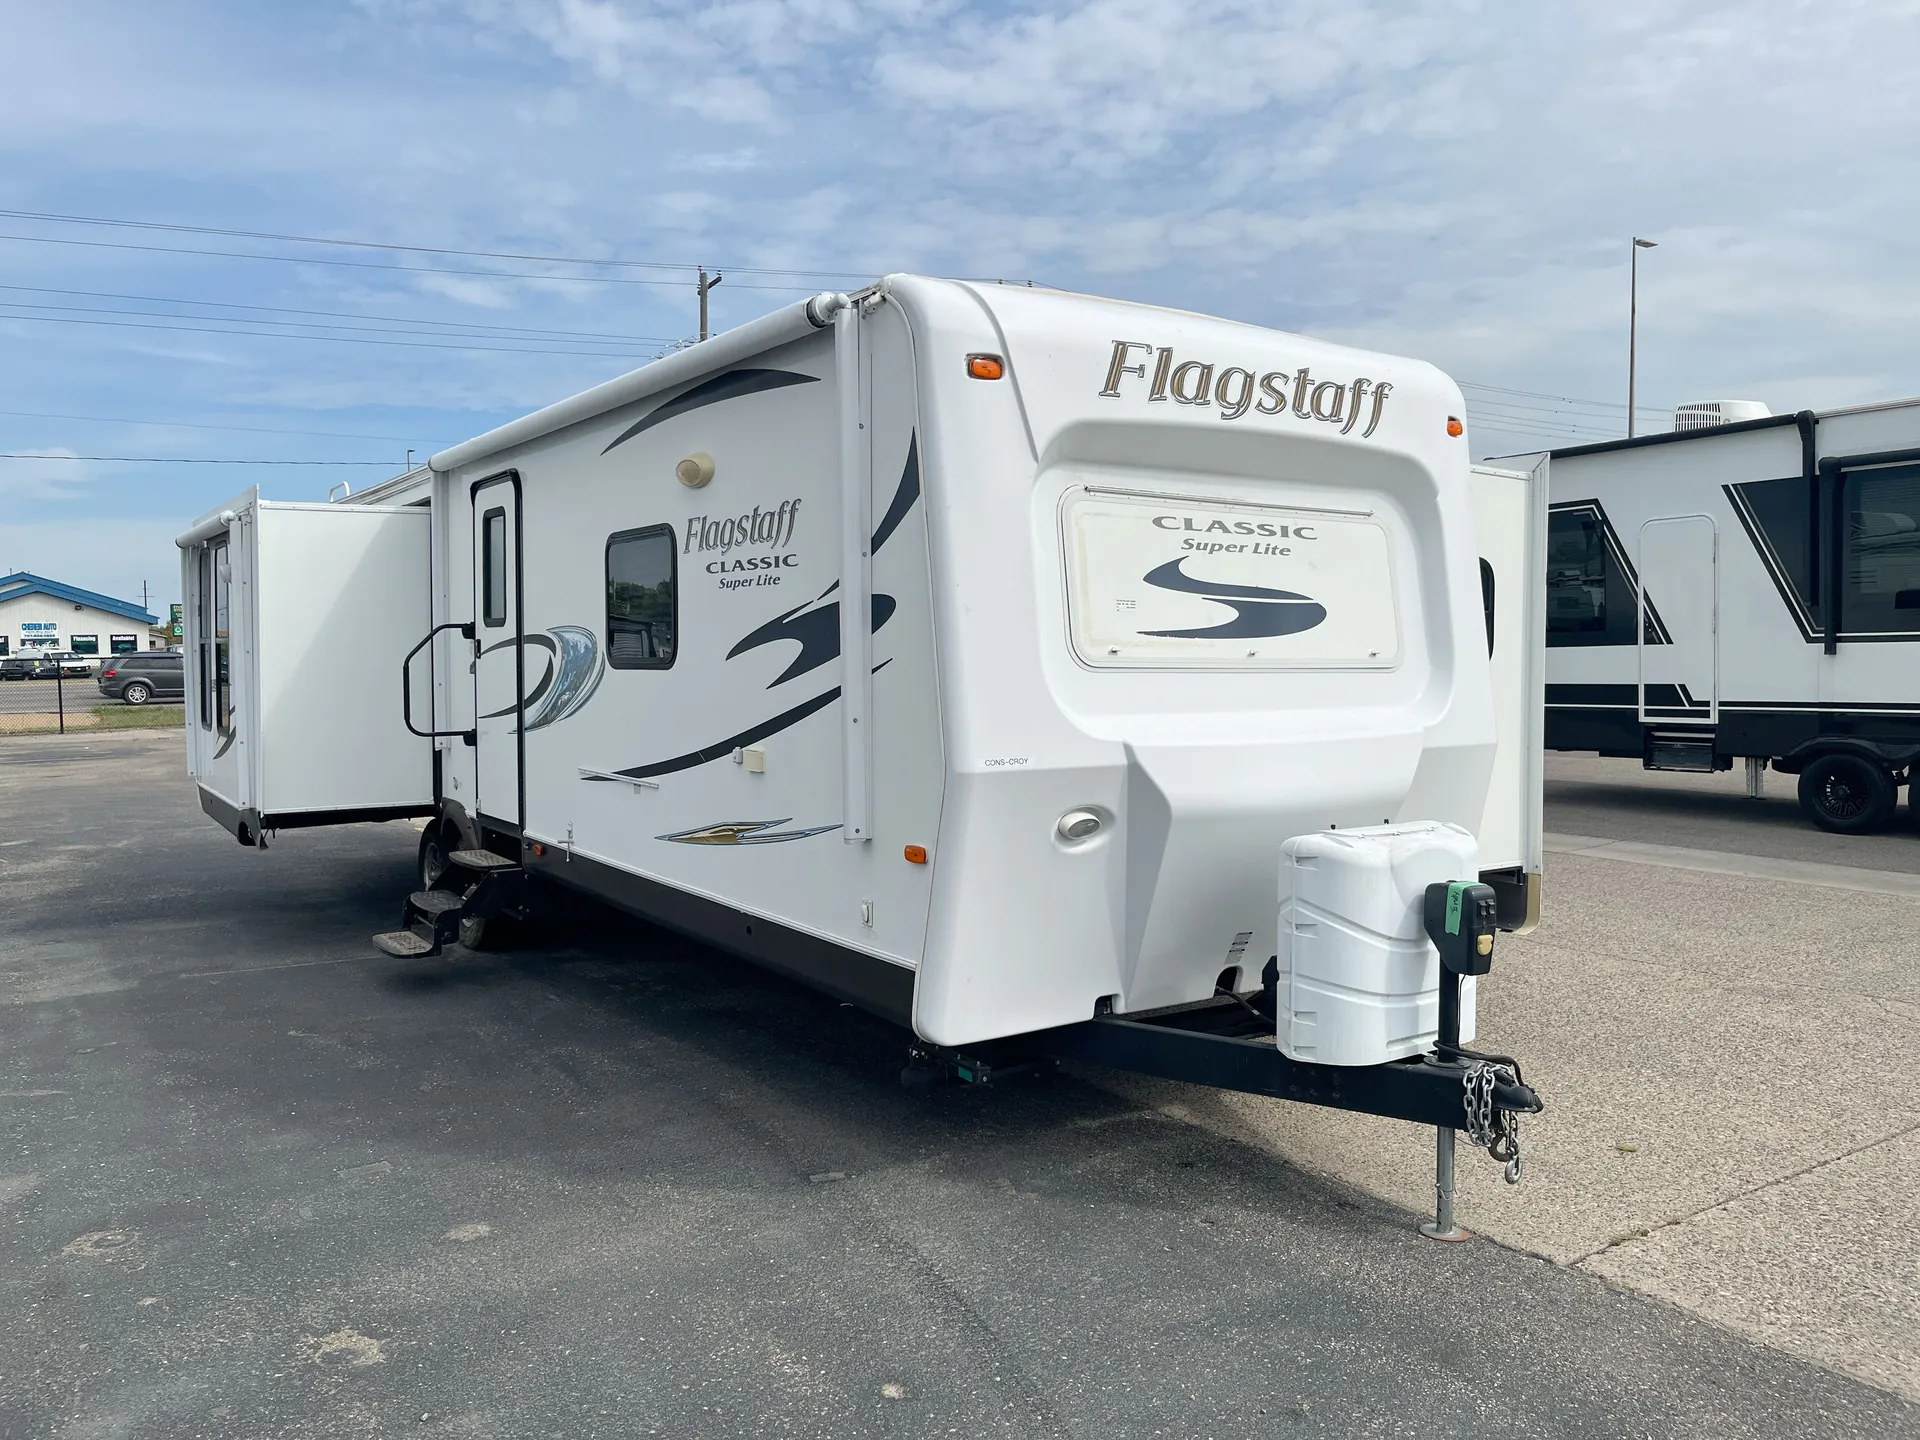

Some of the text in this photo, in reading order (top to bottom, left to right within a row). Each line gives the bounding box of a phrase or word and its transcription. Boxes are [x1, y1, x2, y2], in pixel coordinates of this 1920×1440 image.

[1098, 339, 1394, 438] Flagstaff
[683, 498, 802, 556] Flagstaff
[1152, 515, 1318, 541] CLASSIC
[1180, 537, 1292, 557] Super Lite
[705, 554, 799, 574] CLASSIC
[718, 574, 781, 591] Super Lite
[985, 758, 1029, 766] CONS-CROY
